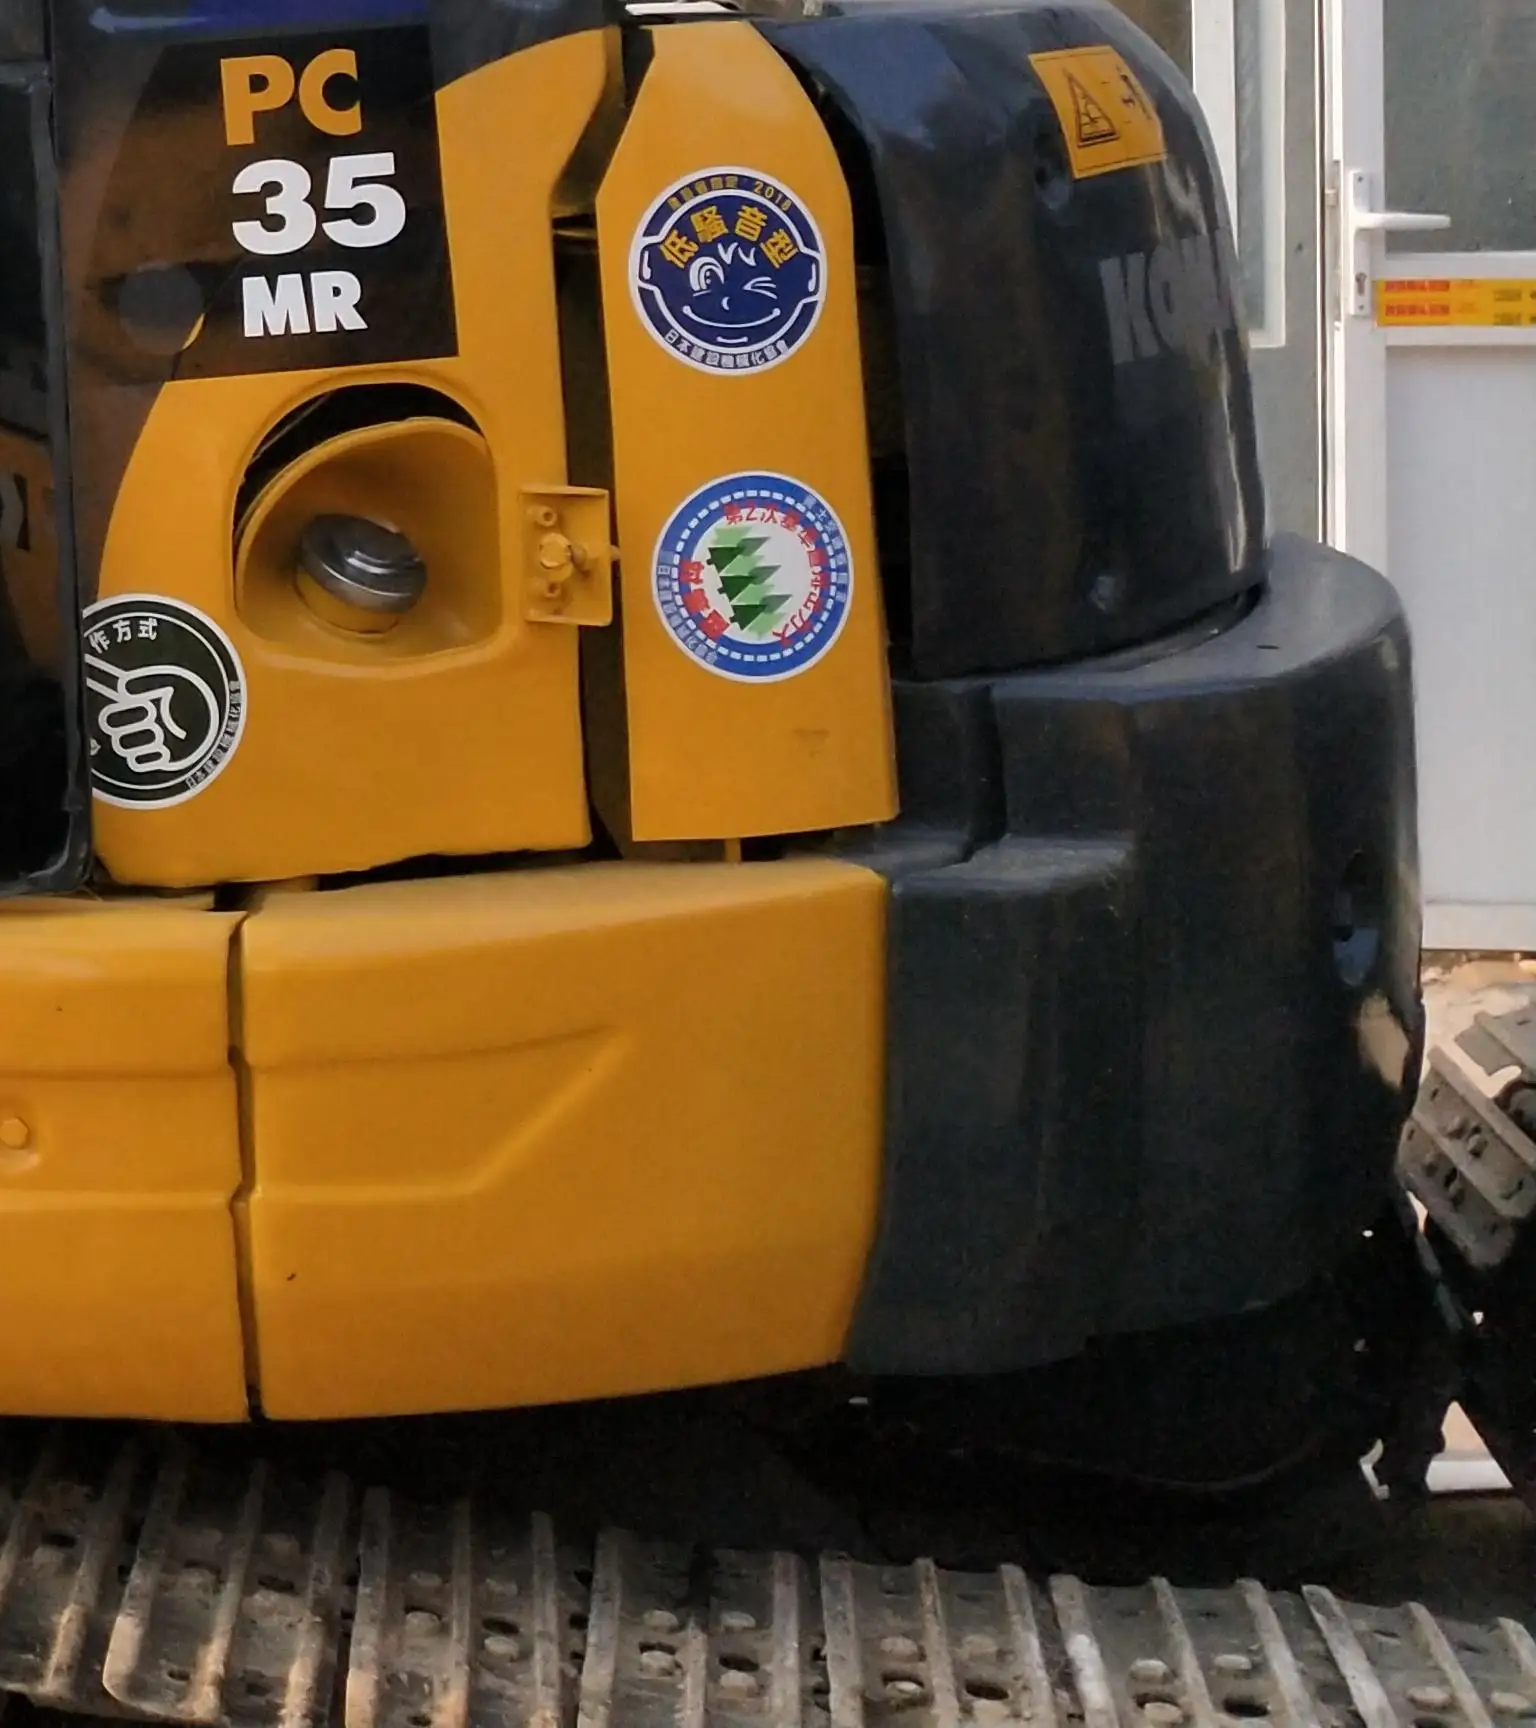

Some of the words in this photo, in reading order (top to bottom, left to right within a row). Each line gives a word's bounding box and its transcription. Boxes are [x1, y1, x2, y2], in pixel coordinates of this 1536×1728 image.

[220, 48, 363, 146] PC
[232, 152, 406, 256] 35
[242, 271, 368, 338] MR
